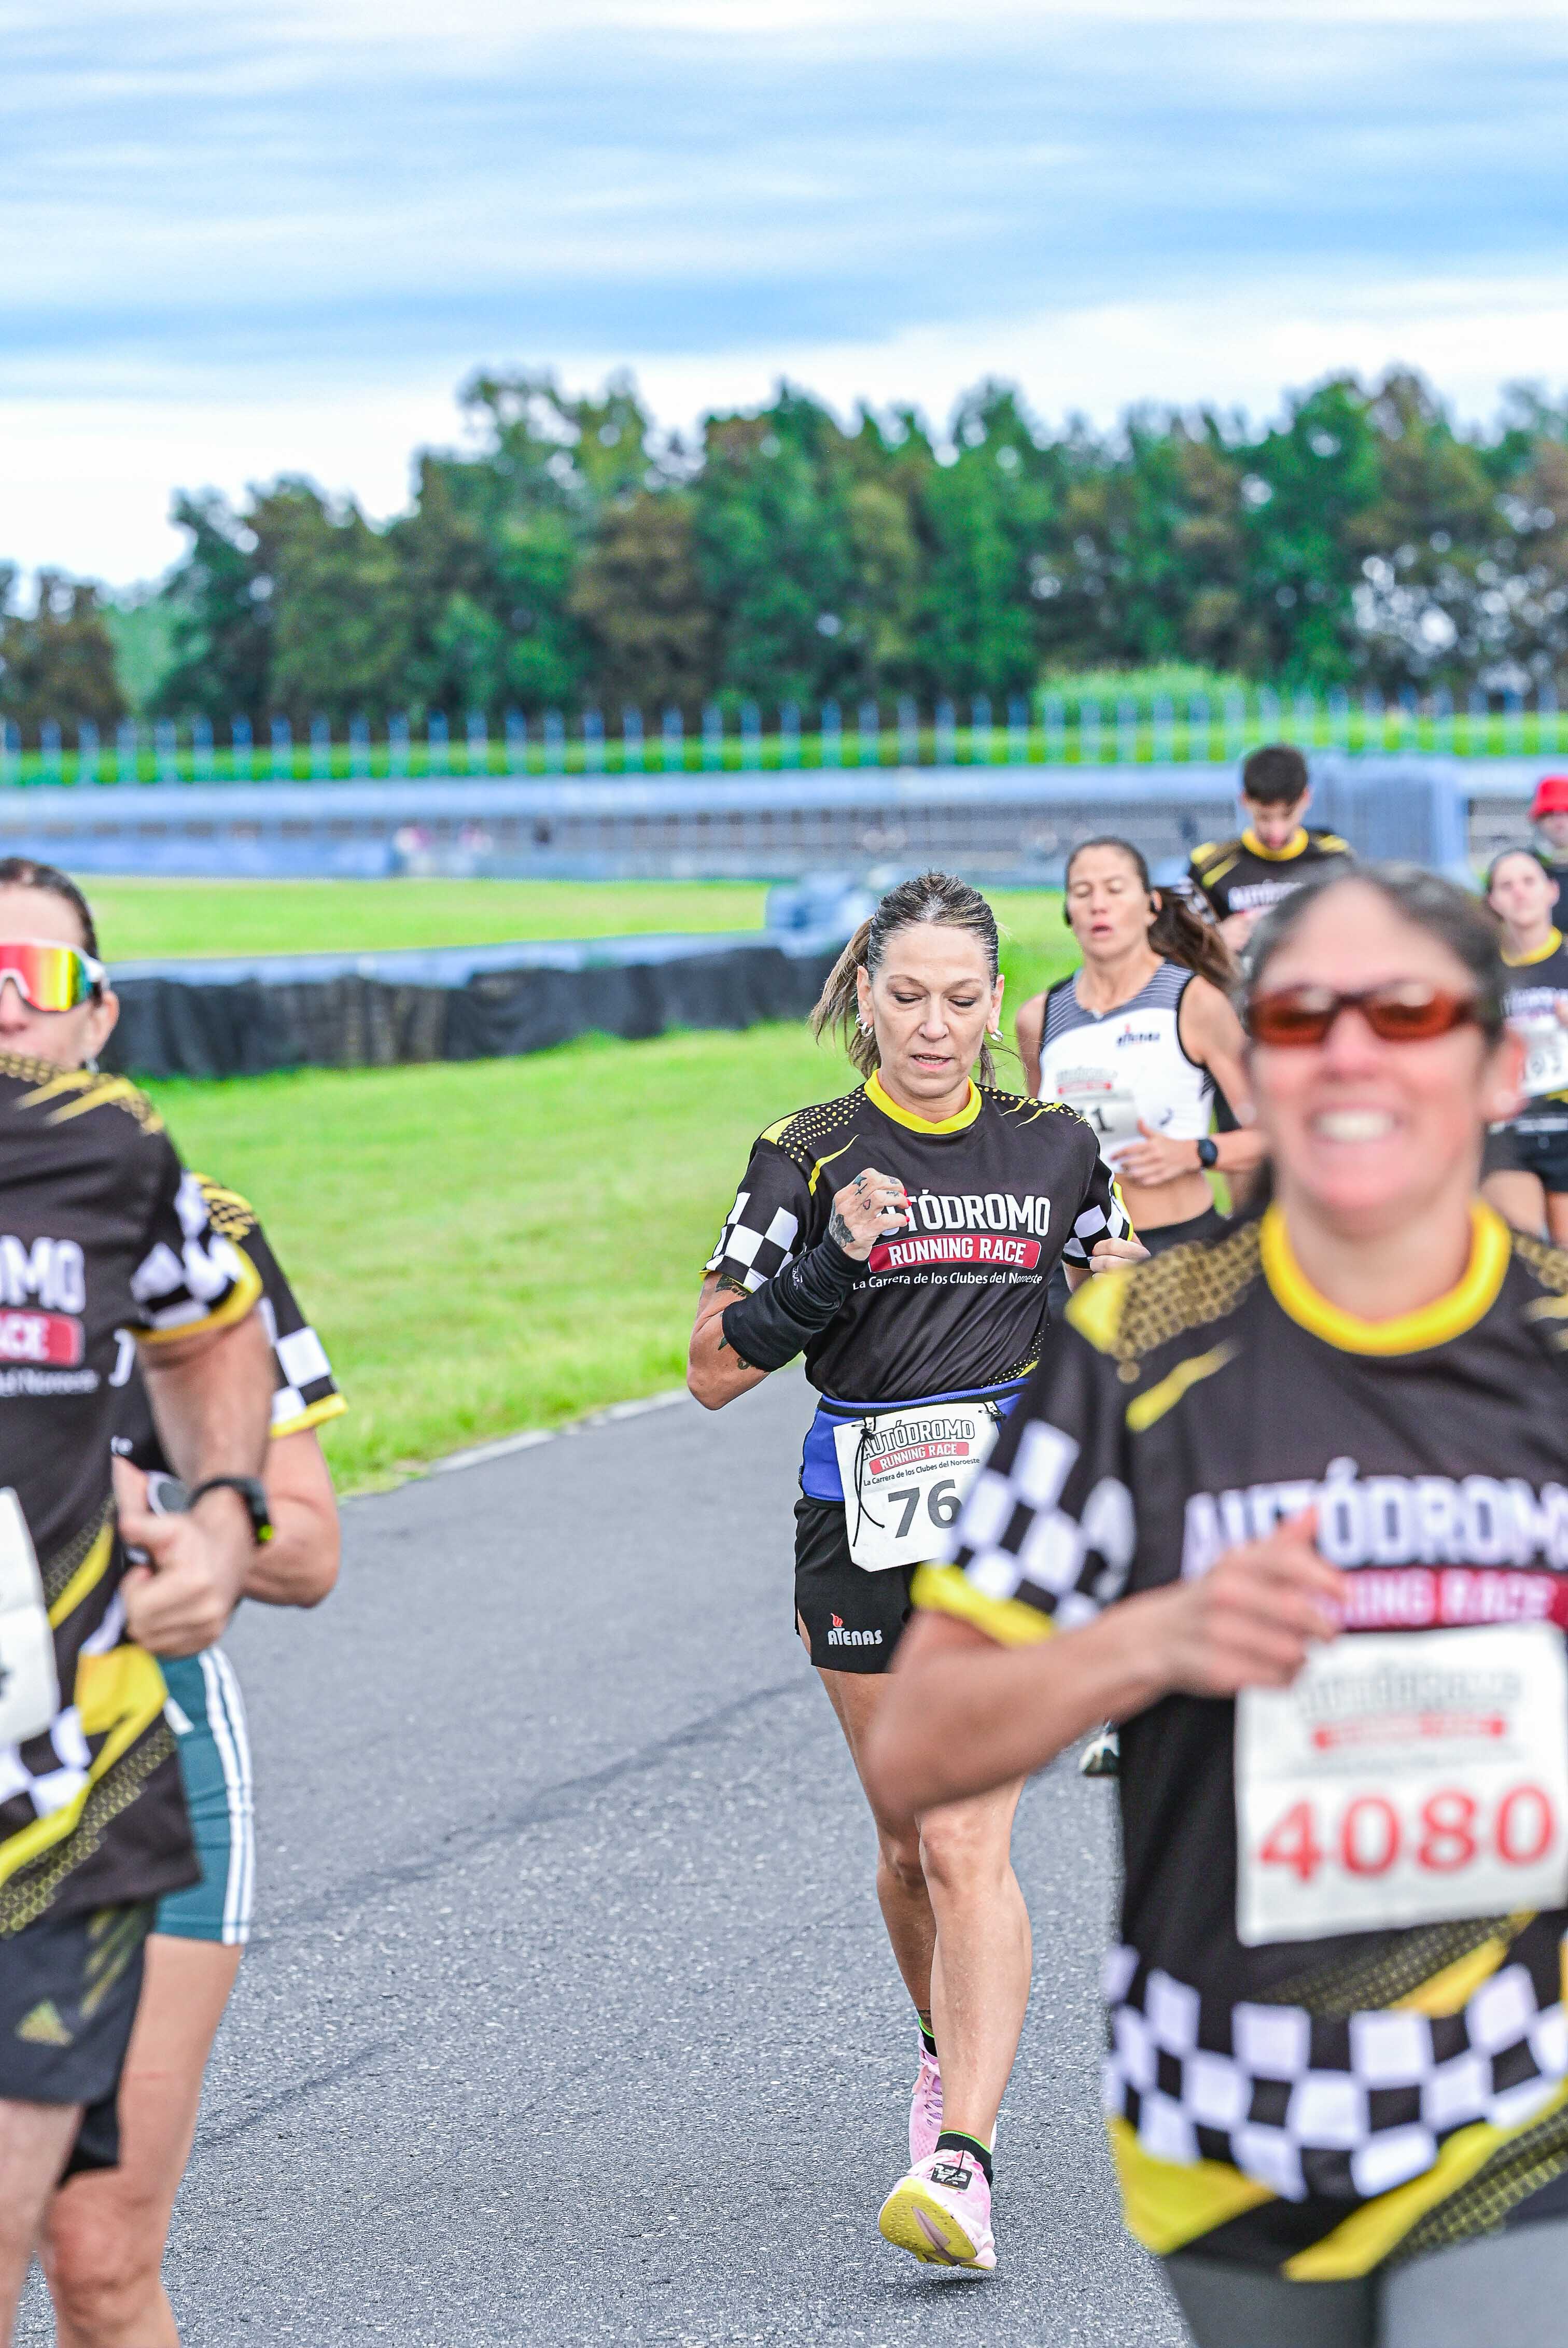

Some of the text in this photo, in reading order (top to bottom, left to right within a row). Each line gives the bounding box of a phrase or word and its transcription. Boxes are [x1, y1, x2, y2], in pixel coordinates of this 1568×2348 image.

[877, 1189, 1051, 1237] TÓDROMO
[887, 1237, 1027, 1266] RUNNING RACE
[853, 1272, 1043, 1290] La Carrera de los Clubes del Noroeste
[863, 1419, 975, 1461] AUTÓDROMO
[879, 1443, 957, 1470] RUNNING RACE
[872, 1473, 895, 1484] Carrera
[916, 1464, 937, 1474] Clubes
[888, 1479, 963, 1538] 76
[1258, 1782, 1558, 1884] 4080
